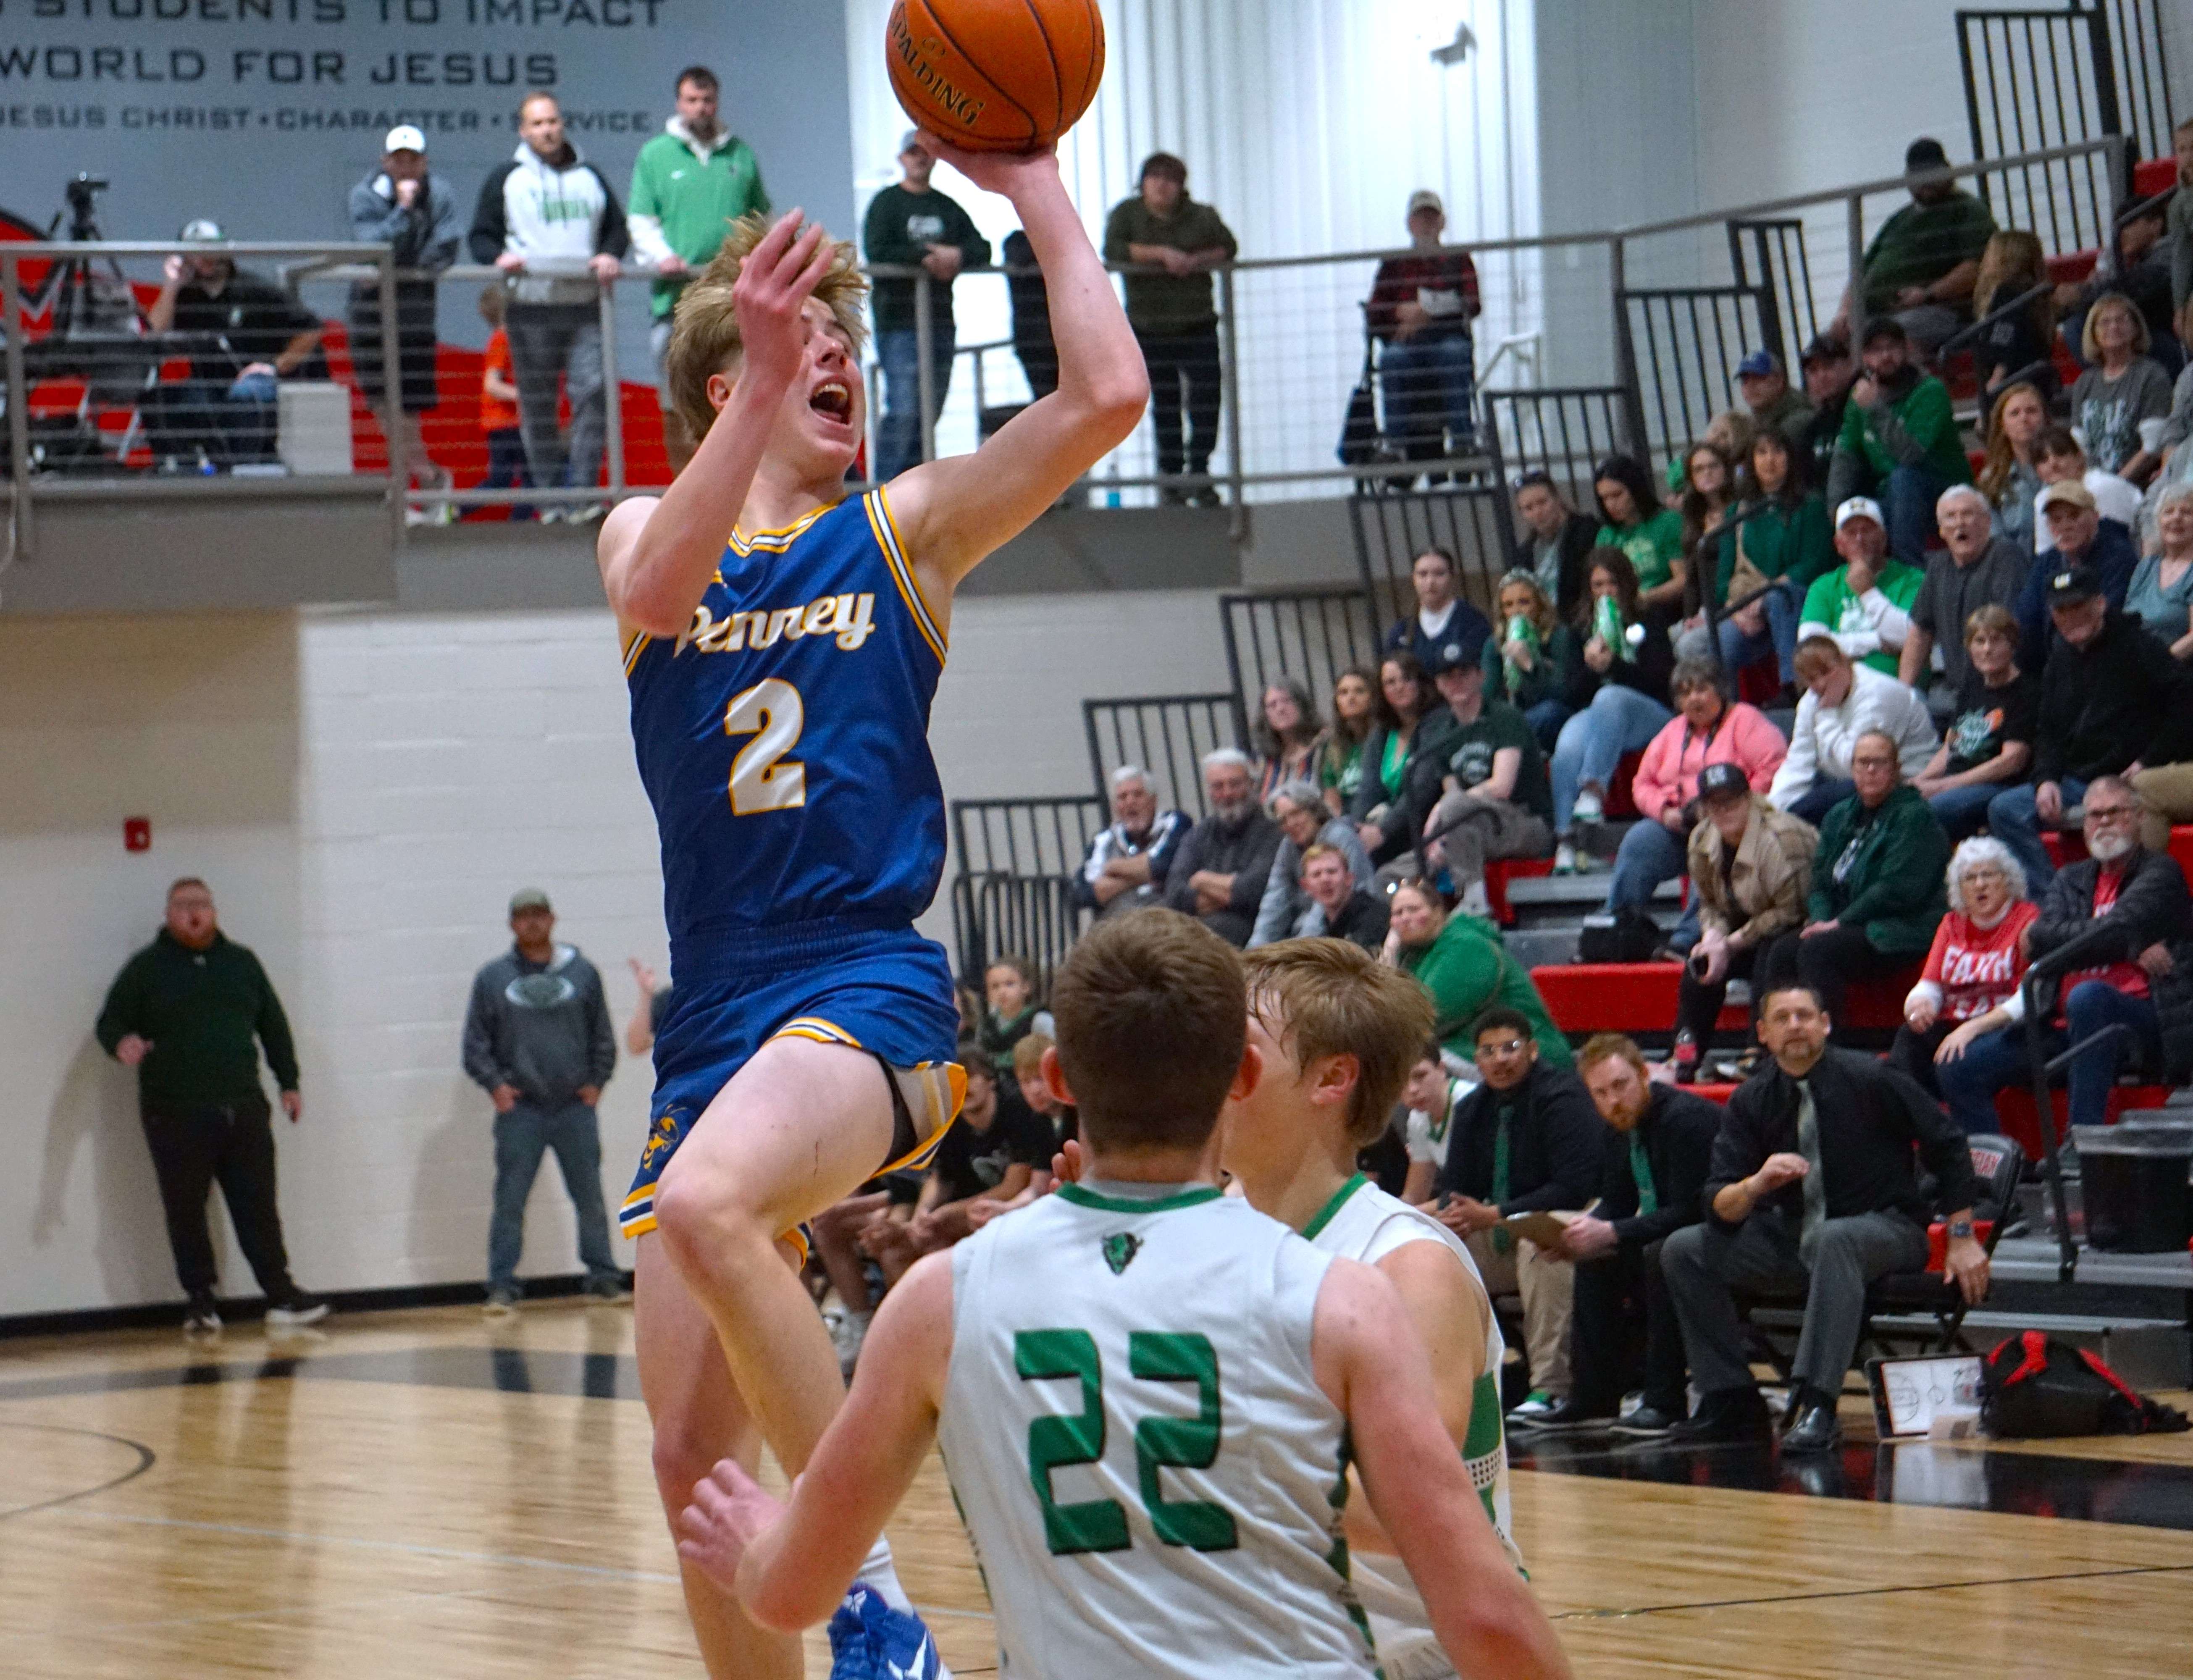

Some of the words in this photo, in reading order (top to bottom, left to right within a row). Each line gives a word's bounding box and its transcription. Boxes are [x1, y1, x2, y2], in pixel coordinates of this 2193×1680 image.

[467, 0, 667, 27] IMPACT
[0, 46, 205, 81] WORLD
[234, 48, 345, 83] FOR
[370, 52, 558, 85] JESUS
[121, 106, 250, 130] CHRIST
[276, 108, 479, 132] CHARACTER
[673, 593, 875, 658] Penney
[724, 677, 806, 816] 2
[1941, 944, 2015, 984] FAITH
[1014, 1328, 1238, 1555] 22
